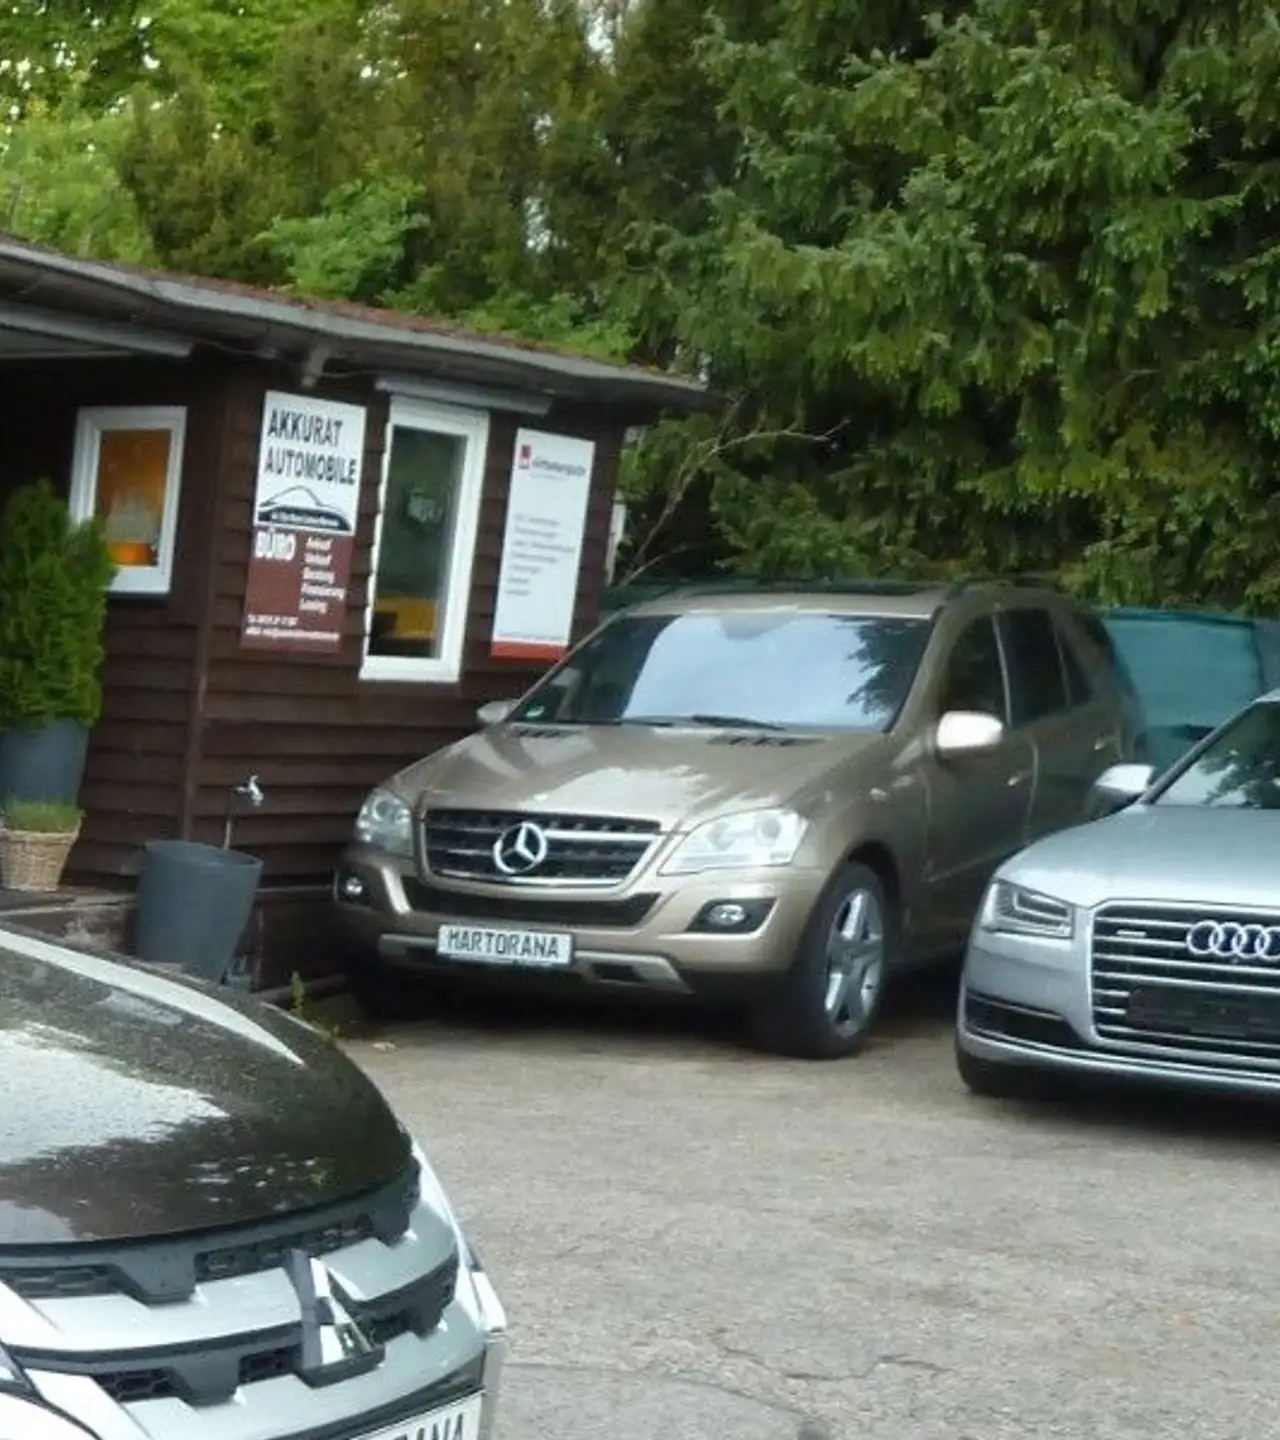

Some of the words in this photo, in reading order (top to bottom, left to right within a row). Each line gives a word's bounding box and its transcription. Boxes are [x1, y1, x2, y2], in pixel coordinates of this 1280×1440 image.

[267, 408, 343, 447] AKKURAT
[264, 446, 357, 485] AUTOMOBILE
[447, 928, 559, 960] MARTORANA
